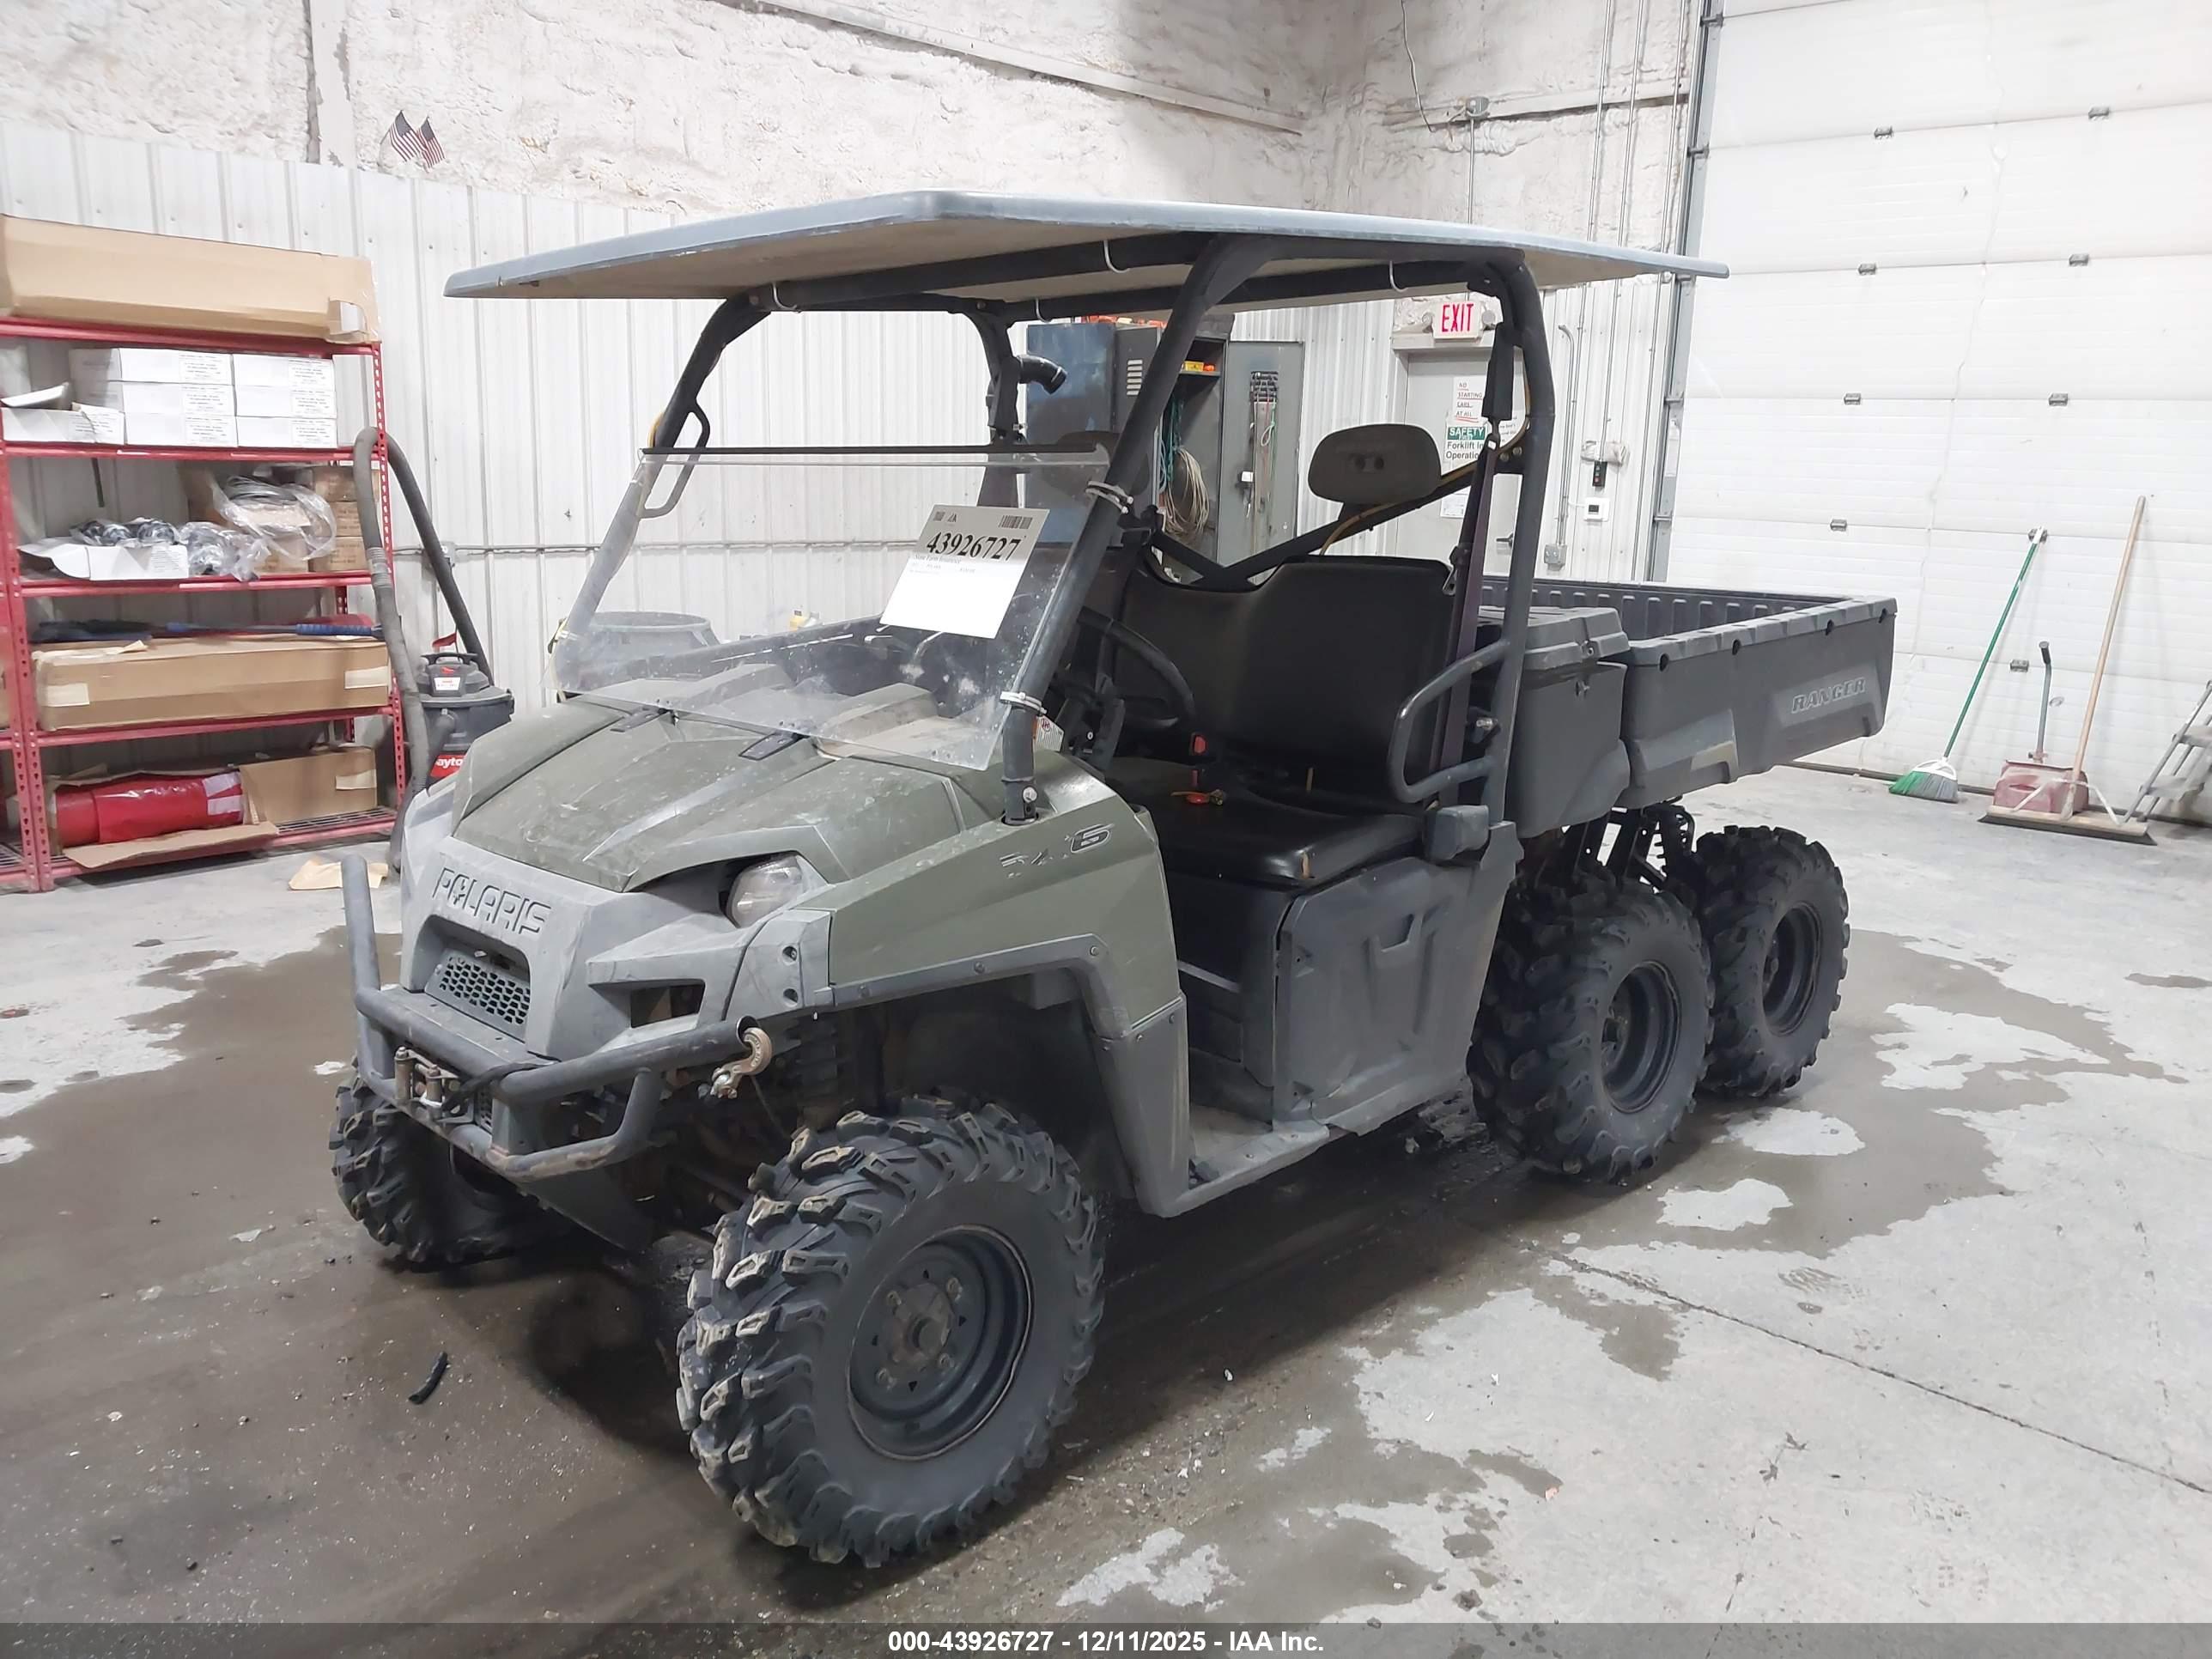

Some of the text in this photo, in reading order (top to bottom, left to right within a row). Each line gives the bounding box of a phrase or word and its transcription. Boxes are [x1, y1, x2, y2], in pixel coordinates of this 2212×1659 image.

[1442, 303, 1474, 332] EXIT
[1449, 427, 1485, 436] SAFETY
[1445, 451, 1480, 460] Operatio
[927, 532, 1022, 562] 43926727
[1791, 677, 1866, 714] RANGER
[435, 757, 464, 769] ayto
[432, 867, 552, 934] POLARIS
